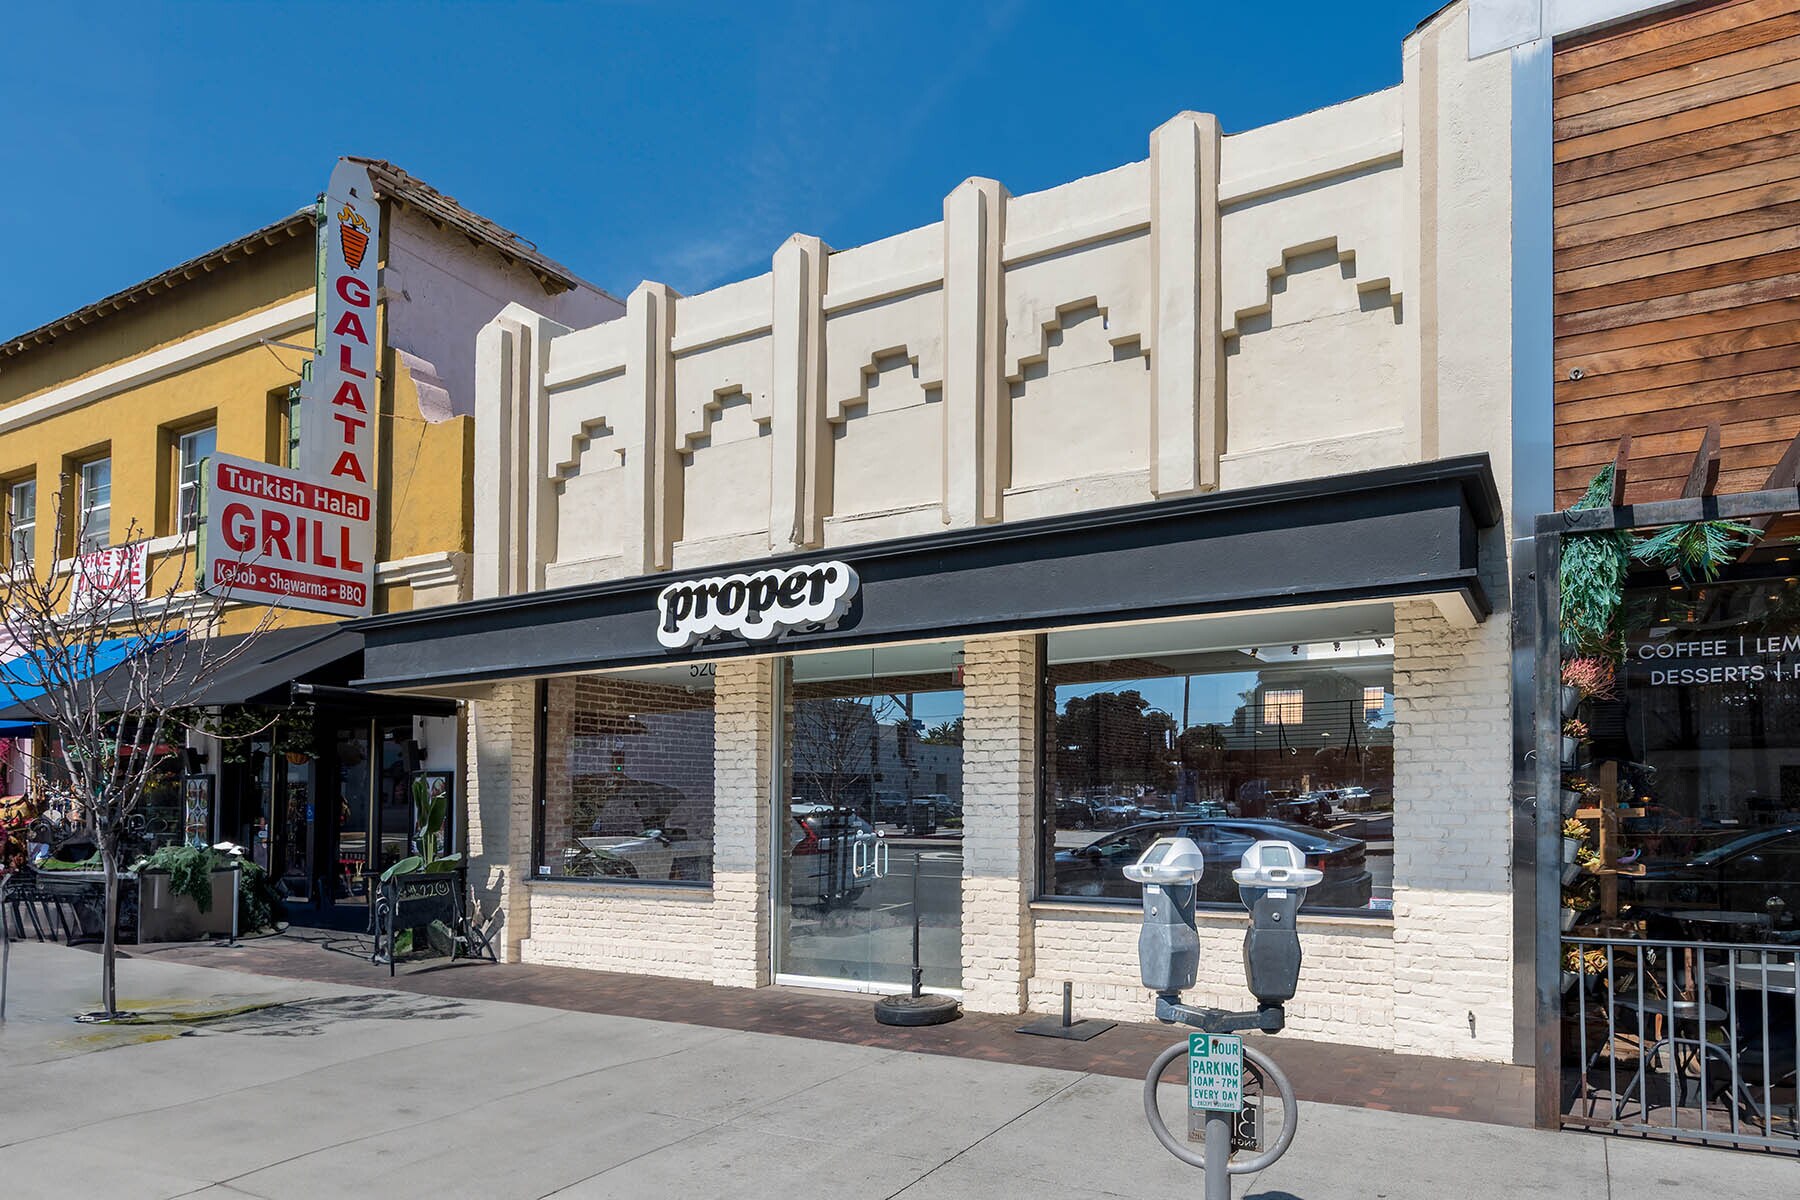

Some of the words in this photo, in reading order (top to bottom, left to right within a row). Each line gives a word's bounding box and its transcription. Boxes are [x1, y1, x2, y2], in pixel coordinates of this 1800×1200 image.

[330, 275, 371, 483] GALATA
[225, 467, 305, 504] Turkish
[314, 489, 363, 518] Halal
[221, 502, 364, 574] GRILL
[269, 572, 328, 597] Shawarma
[339, 583, 362, 605] BBQ
[663, 566, 838, 633] proper
[1638, 640, 1727, 660] COFFEE
[1650, 665, 1765, 686] DESSERTS
[1193, 1037, 1206, 1054] 2
[1211, 1043, 1238, 1055] HOUR
[1192, 1060, 1239, 1077] PARKING
[1193, 1076, 1214, 1087] 10AM
[1222, 1077, 1239, 1089] 7PM
[1194, 1088, 1219, 1100] EVERY
[1222, 1091, 1239, 1102] DAY
